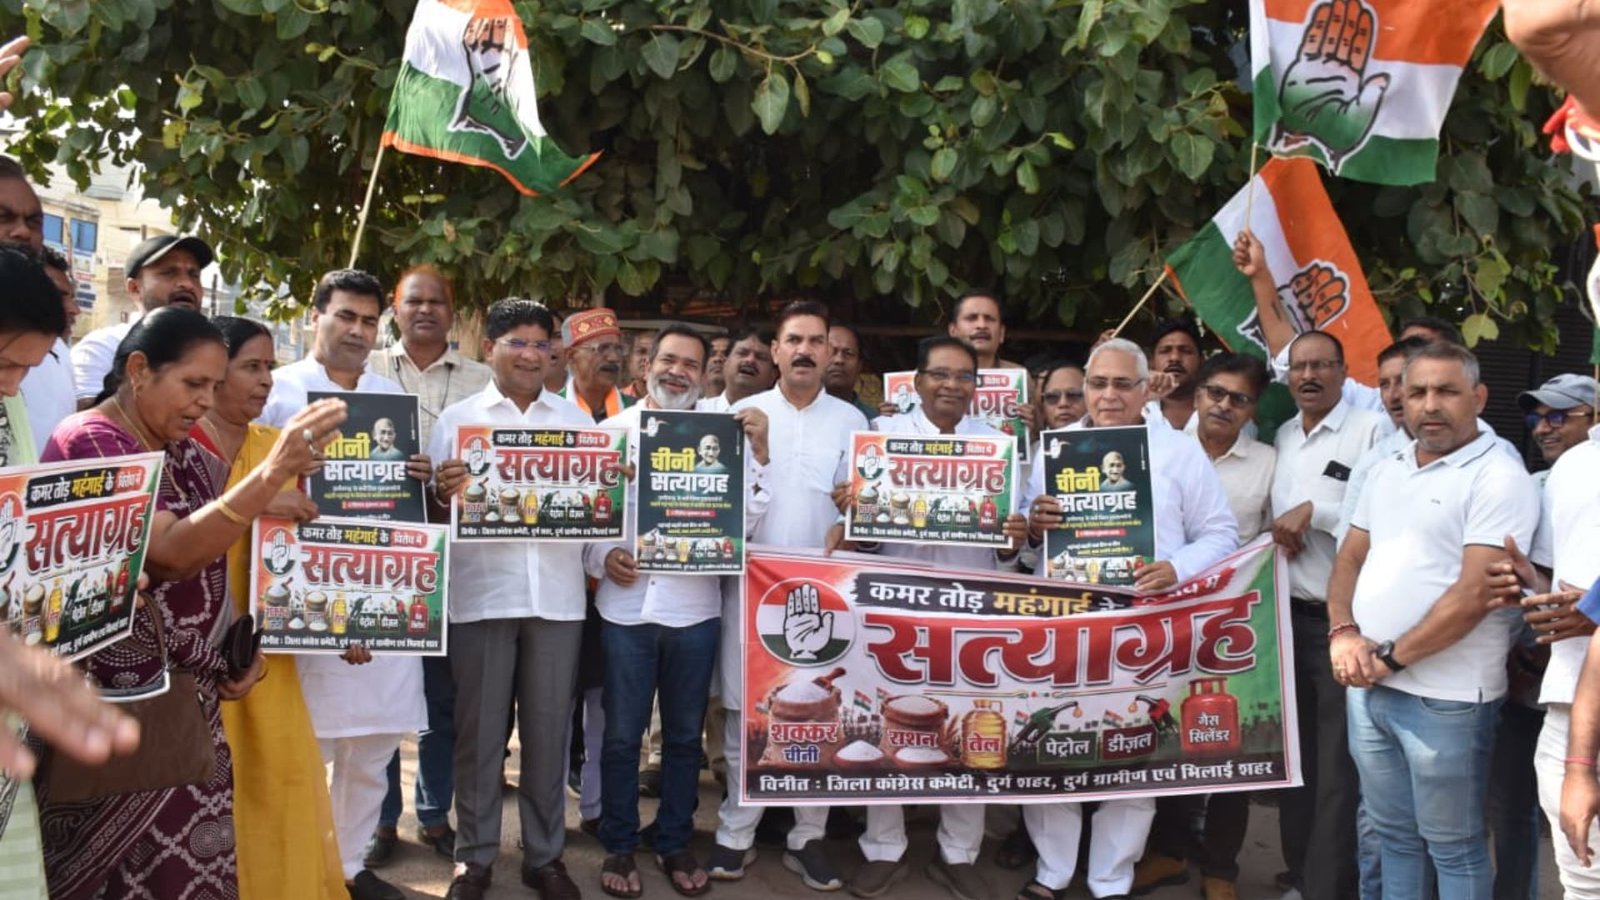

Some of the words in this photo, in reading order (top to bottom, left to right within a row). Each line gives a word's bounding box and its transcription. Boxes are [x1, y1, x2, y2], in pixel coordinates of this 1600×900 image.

[534, 430, 564, 447] महंगाई
[495, 449, 622, 488] सत्याग्रह
[650, 446, 697, 472] चीनी
[323, 459, 407, 484] सत्याग्रह
[650, 472, 729, 494] सत्याग्रह
[888, 456, 1008, 494] सत्याग्रह
[1056, 467, 1100, 492] चीनी
[71, 470, 107, 498] महंगाई
[1056, 491, 1137, 512] सत्याग्रह
[25, 491, 152, 575] सत्याग्रह
[302, 526, 326, 539] कमर
[344, 527, 378, 545] महंगाई
[379, 529, 389, 544] के
[301, 544, 441, 594] सत्याग्रह
[870, 581, 933, 605] कमर
[939, 582, 985, 613] तोड़
[992, 588, 1093, 617] महंगाई
[863, 590, 1261, 687] सत्याग्रह
[771, 722, 839, 744] शक्कर
[889, 729, 940, 748] राशन
[967, 732, 1001, 753] तेल
[1108, 732, 1152, 754] डीज़ल
[1189, 728, 1230, 743] सिलेंडर
[784, 745, 820, 764] चीनी
[1046, 740, 1090, 758] पेट्रोल
[760, 774, 810, 792] विनीत
[826, 774, 872, 792] जिला
[875, 773, 924, 792] कांग्रेस
[929, 773, 980, 792] कमेटी,
[987, 774, 1011, 793] दुर्ग
[1017, 776, 1057, 790] शहर,
[1063, 774, 1087, 792] दुर्ग
[1093, 769, 1147, 787] ग्रामीण
[1152, 763, 1178, 782] एवं
[1181, 761, 1234, 781] भिलाई
[1239, 761, 1274, 777] शहर
